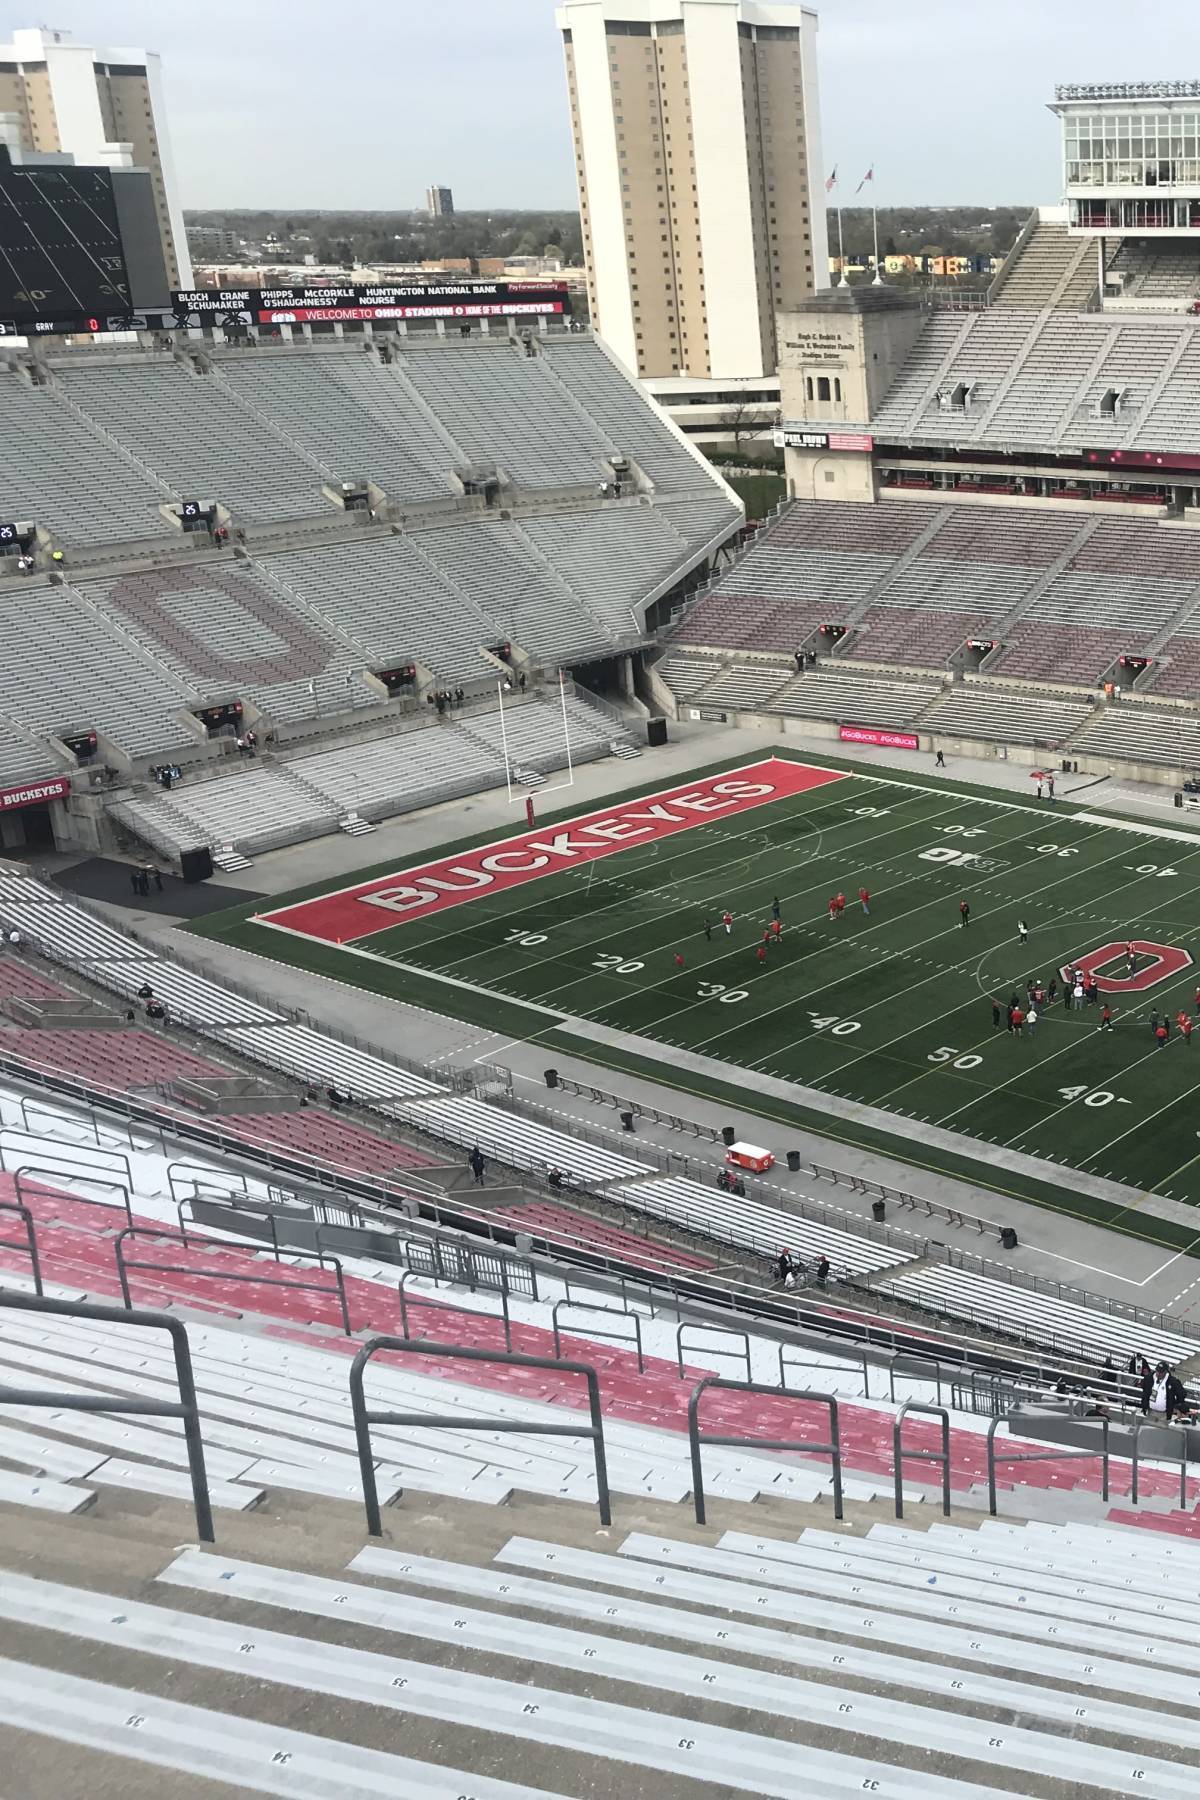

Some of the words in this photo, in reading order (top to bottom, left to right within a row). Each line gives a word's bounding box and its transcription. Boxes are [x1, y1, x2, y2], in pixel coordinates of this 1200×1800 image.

[178, 293, 208, 302] BLOCH
[220, 291, 250, 300] CRANE
[260, 290, 294, 299] PHIPPS
[304, 289, 355, 298] McCORKLE
[366, 287, 425, 297] HUNTINGTON
[428, 286, 471, 295] NATIONAL
[473, 285, 497, 294] BANK
[187, 301, 245, 310] SCHUMAKER
[264, 298, 338, 307] O'SHAUGHNESSY
[359, 296, 396, 305] NOURSE
[305, 310, 358, 320] WELCOME
[360, 309, 372, 319] TO
[374, 308, 403, 318] OHIO
[405, 306, 453, 317] STADIUM
[465, 305, 482, 315] HOME
[502, 303, 554, 314] BUCKEYES
[35, 322, 54, 331] GRAY
[3, 783, 64, 805] BUCKEYES
[858, 806, 893, 819] 10
[943, 824, 987, 838] 20
[357, 780, 776, 913] BUCKEYES
[1035, 844, 1080, 858] 30
[1135, 864, 1179, 878] 40
[504, 927, 549, 947] 10
[591, 952, 645, 975] 20
[696, 983, 750, 1005] 30
[811, 1015, 862, 1037] 40
[926, 1046, 984, 1070] 50
[1056, 1084, 1115, 1108] 40
[333, 1595, 348, 1603] 37
[454, 1620, 467, 1628] 36
[716, 1631, 729, 1639] 34
[239, 1643, 255, 1653] 36
[583, 1648, 597, 1657] 35
[832, 1655, 845, 1664] 33
[392, 1677, 408, 1688] 35
[702, 1674, 717, 1683] 34
[950, 1680, 964, 1689] 32
[522, 1703, 540, 1714] 34
[838, 1703, 853, 1713] 33
[678, 1738, 695, 1750] 33
[988, 1737, 1003, 1747] 32
[272, 1751, 293, 1764] 34
[1132, 1769, 1145, 1779] 31
[862, 1778, 880, 1791] 32
